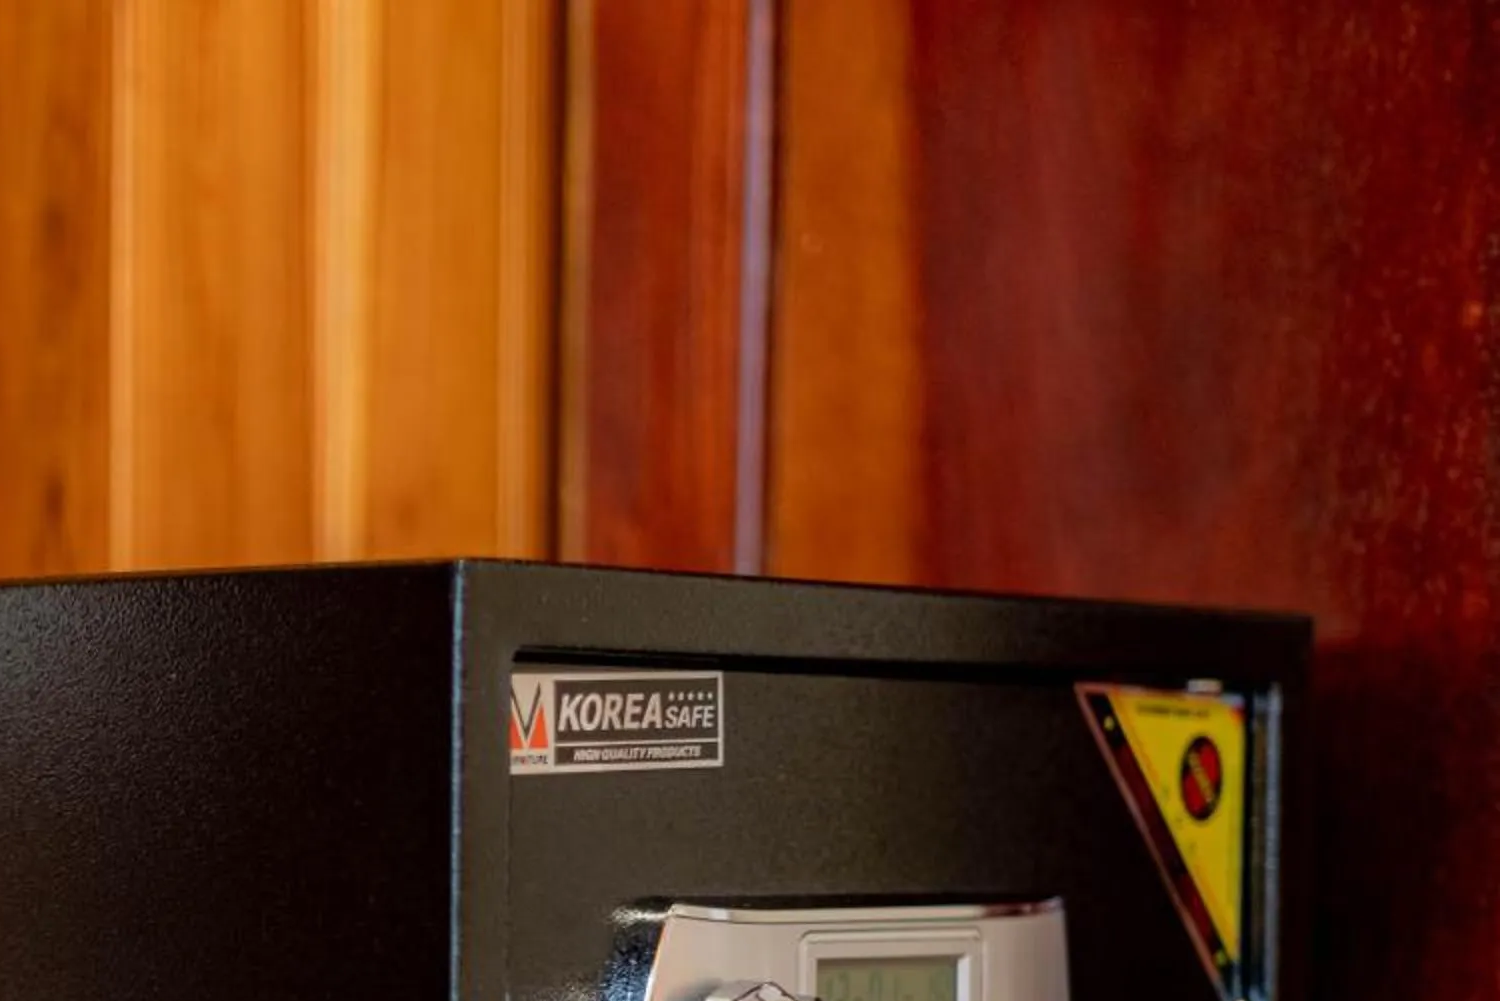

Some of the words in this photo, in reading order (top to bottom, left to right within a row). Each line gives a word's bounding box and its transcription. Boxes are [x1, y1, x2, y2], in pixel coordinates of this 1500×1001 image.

[559, 692, 662, 731] KOREA
[665, 705, 715, 729] SAFE
[574, 748, 600, 761] HIGH
[601, 747, 647, 760] QUALITY
[647, 745, 702, 759] PRODUCTS
